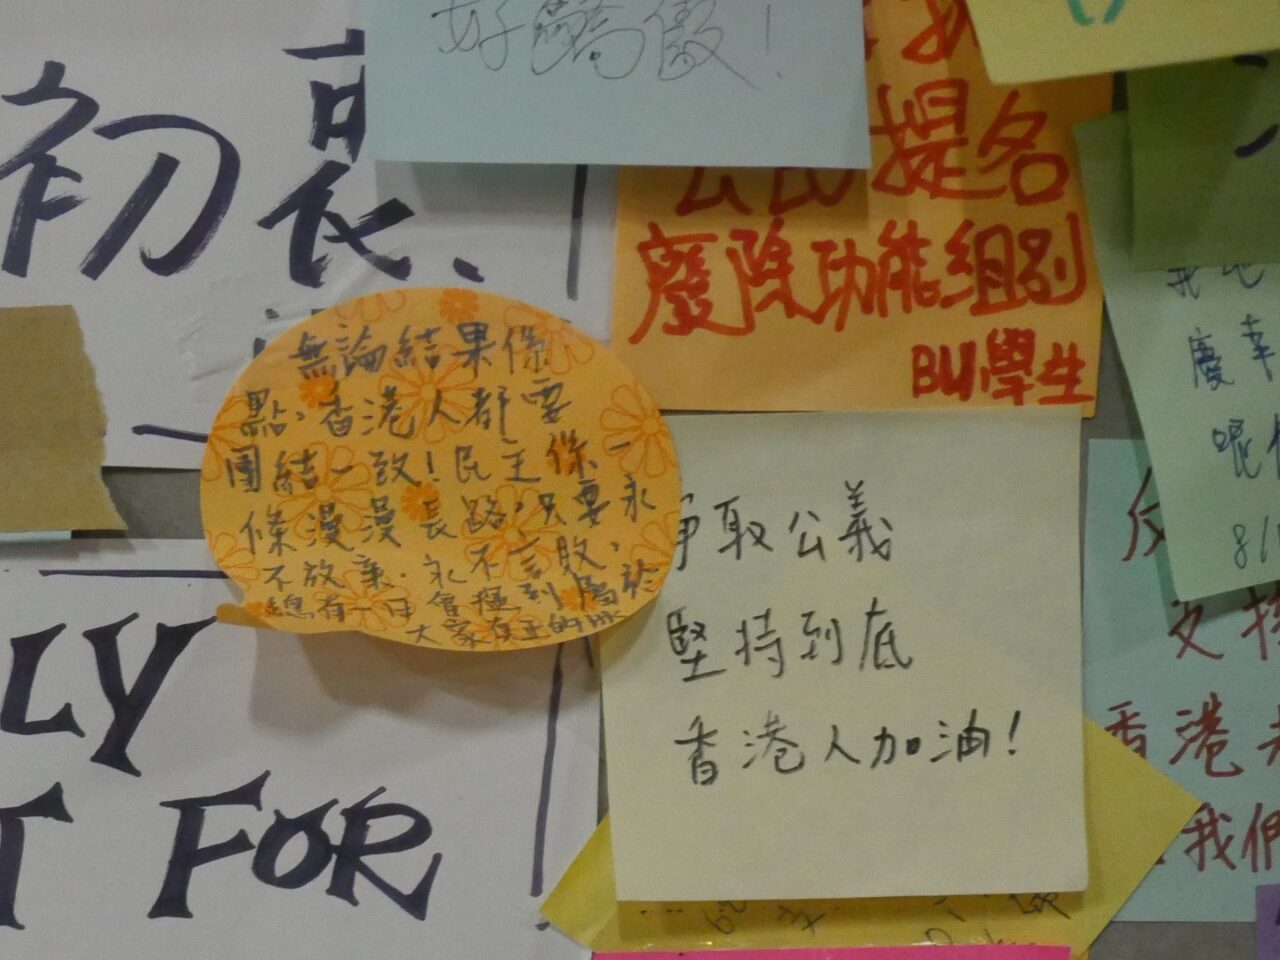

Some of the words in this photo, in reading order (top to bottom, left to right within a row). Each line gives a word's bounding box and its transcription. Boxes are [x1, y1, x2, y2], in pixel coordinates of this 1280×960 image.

[667, 597, 914, 683] 堅持到底
[674, 708, 1022, 787] 香港人加油!
[147, 771, 443, 922] FOR
